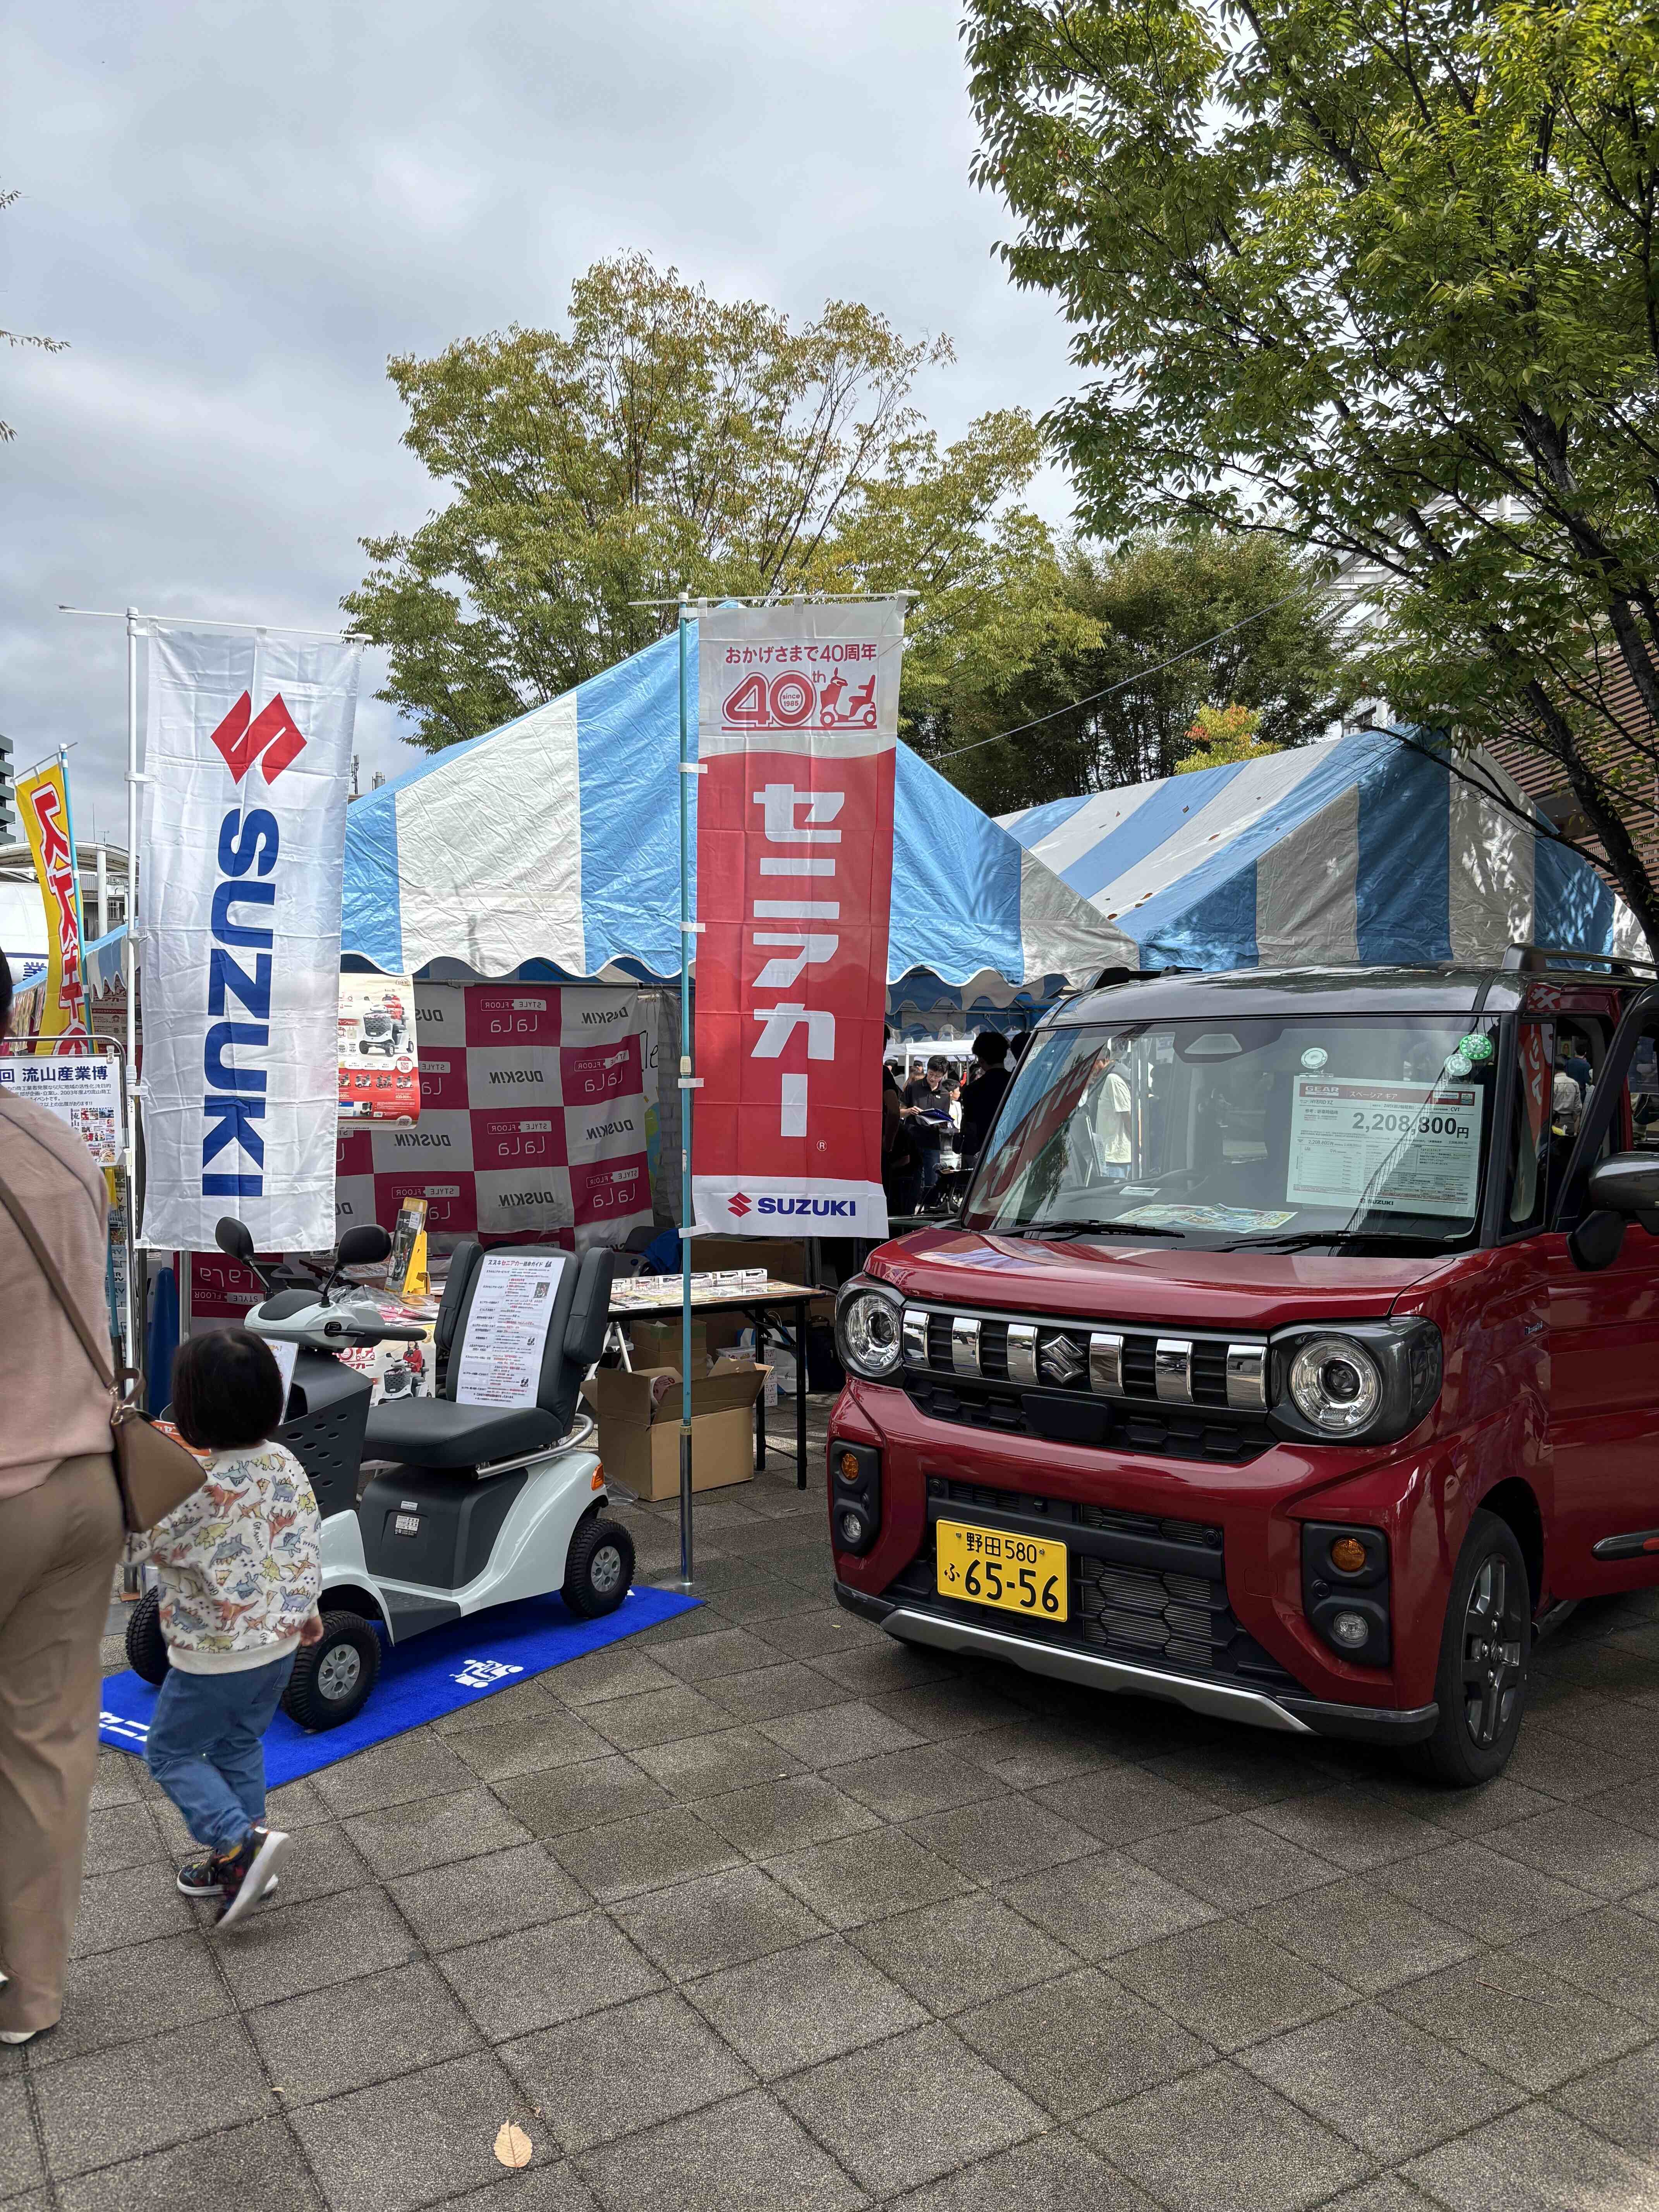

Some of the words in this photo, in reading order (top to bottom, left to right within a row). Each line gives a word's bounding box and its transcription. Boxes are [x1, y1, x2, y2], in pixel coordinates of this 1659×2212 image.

[725, 644, 877, 664] おかげさまで40周年
[750, 784, 845, 1137] セニアカー
[202, 808, 279, 1197] SUZUKI
[22, 1065, 108, 1082] 流山産業博
[1350, 1091, 1383, 1099] スペーシア
[1352, 1112, 1469, 1139] 2,208,800円
[757, 1197, 856, 1216] SUZUKI
[944, 1563, 960, 1582] ふ
[965, 1559, 1060, 1613] 65-56
